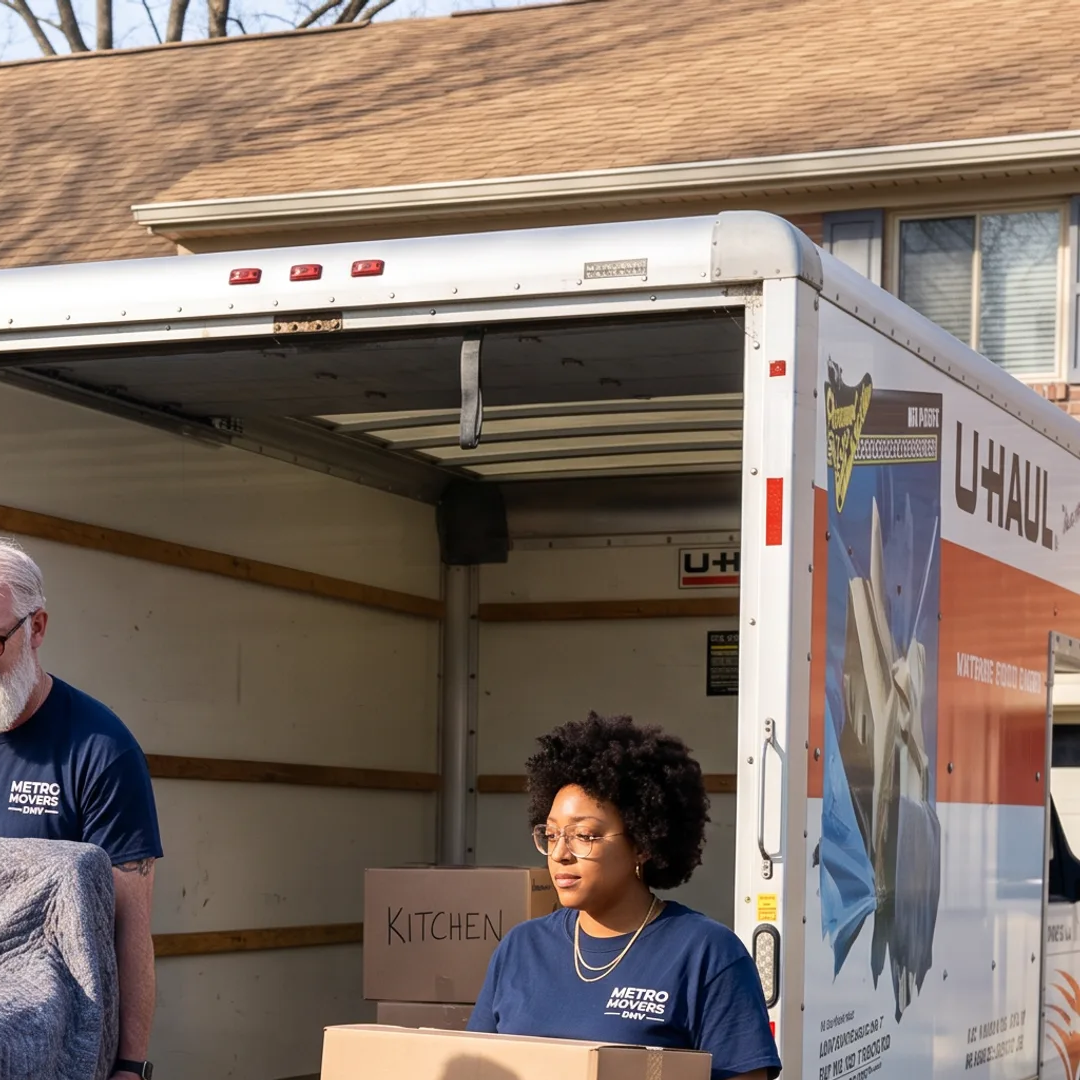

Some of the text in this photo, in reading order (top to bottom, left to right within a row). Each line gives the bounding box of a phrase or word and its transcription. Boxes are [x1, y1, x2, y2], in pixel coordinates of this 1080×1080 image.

[954, 420, 1053, 550] U-HAUL
[10, 780, 61, 796] METRO
[8, 793, 59, 807] MOVERS
[387, 906, 503, 946] KITCHEN
[610, 986, 669, 1003] METRO
[605, 998, 666, 1015] MOVERS
